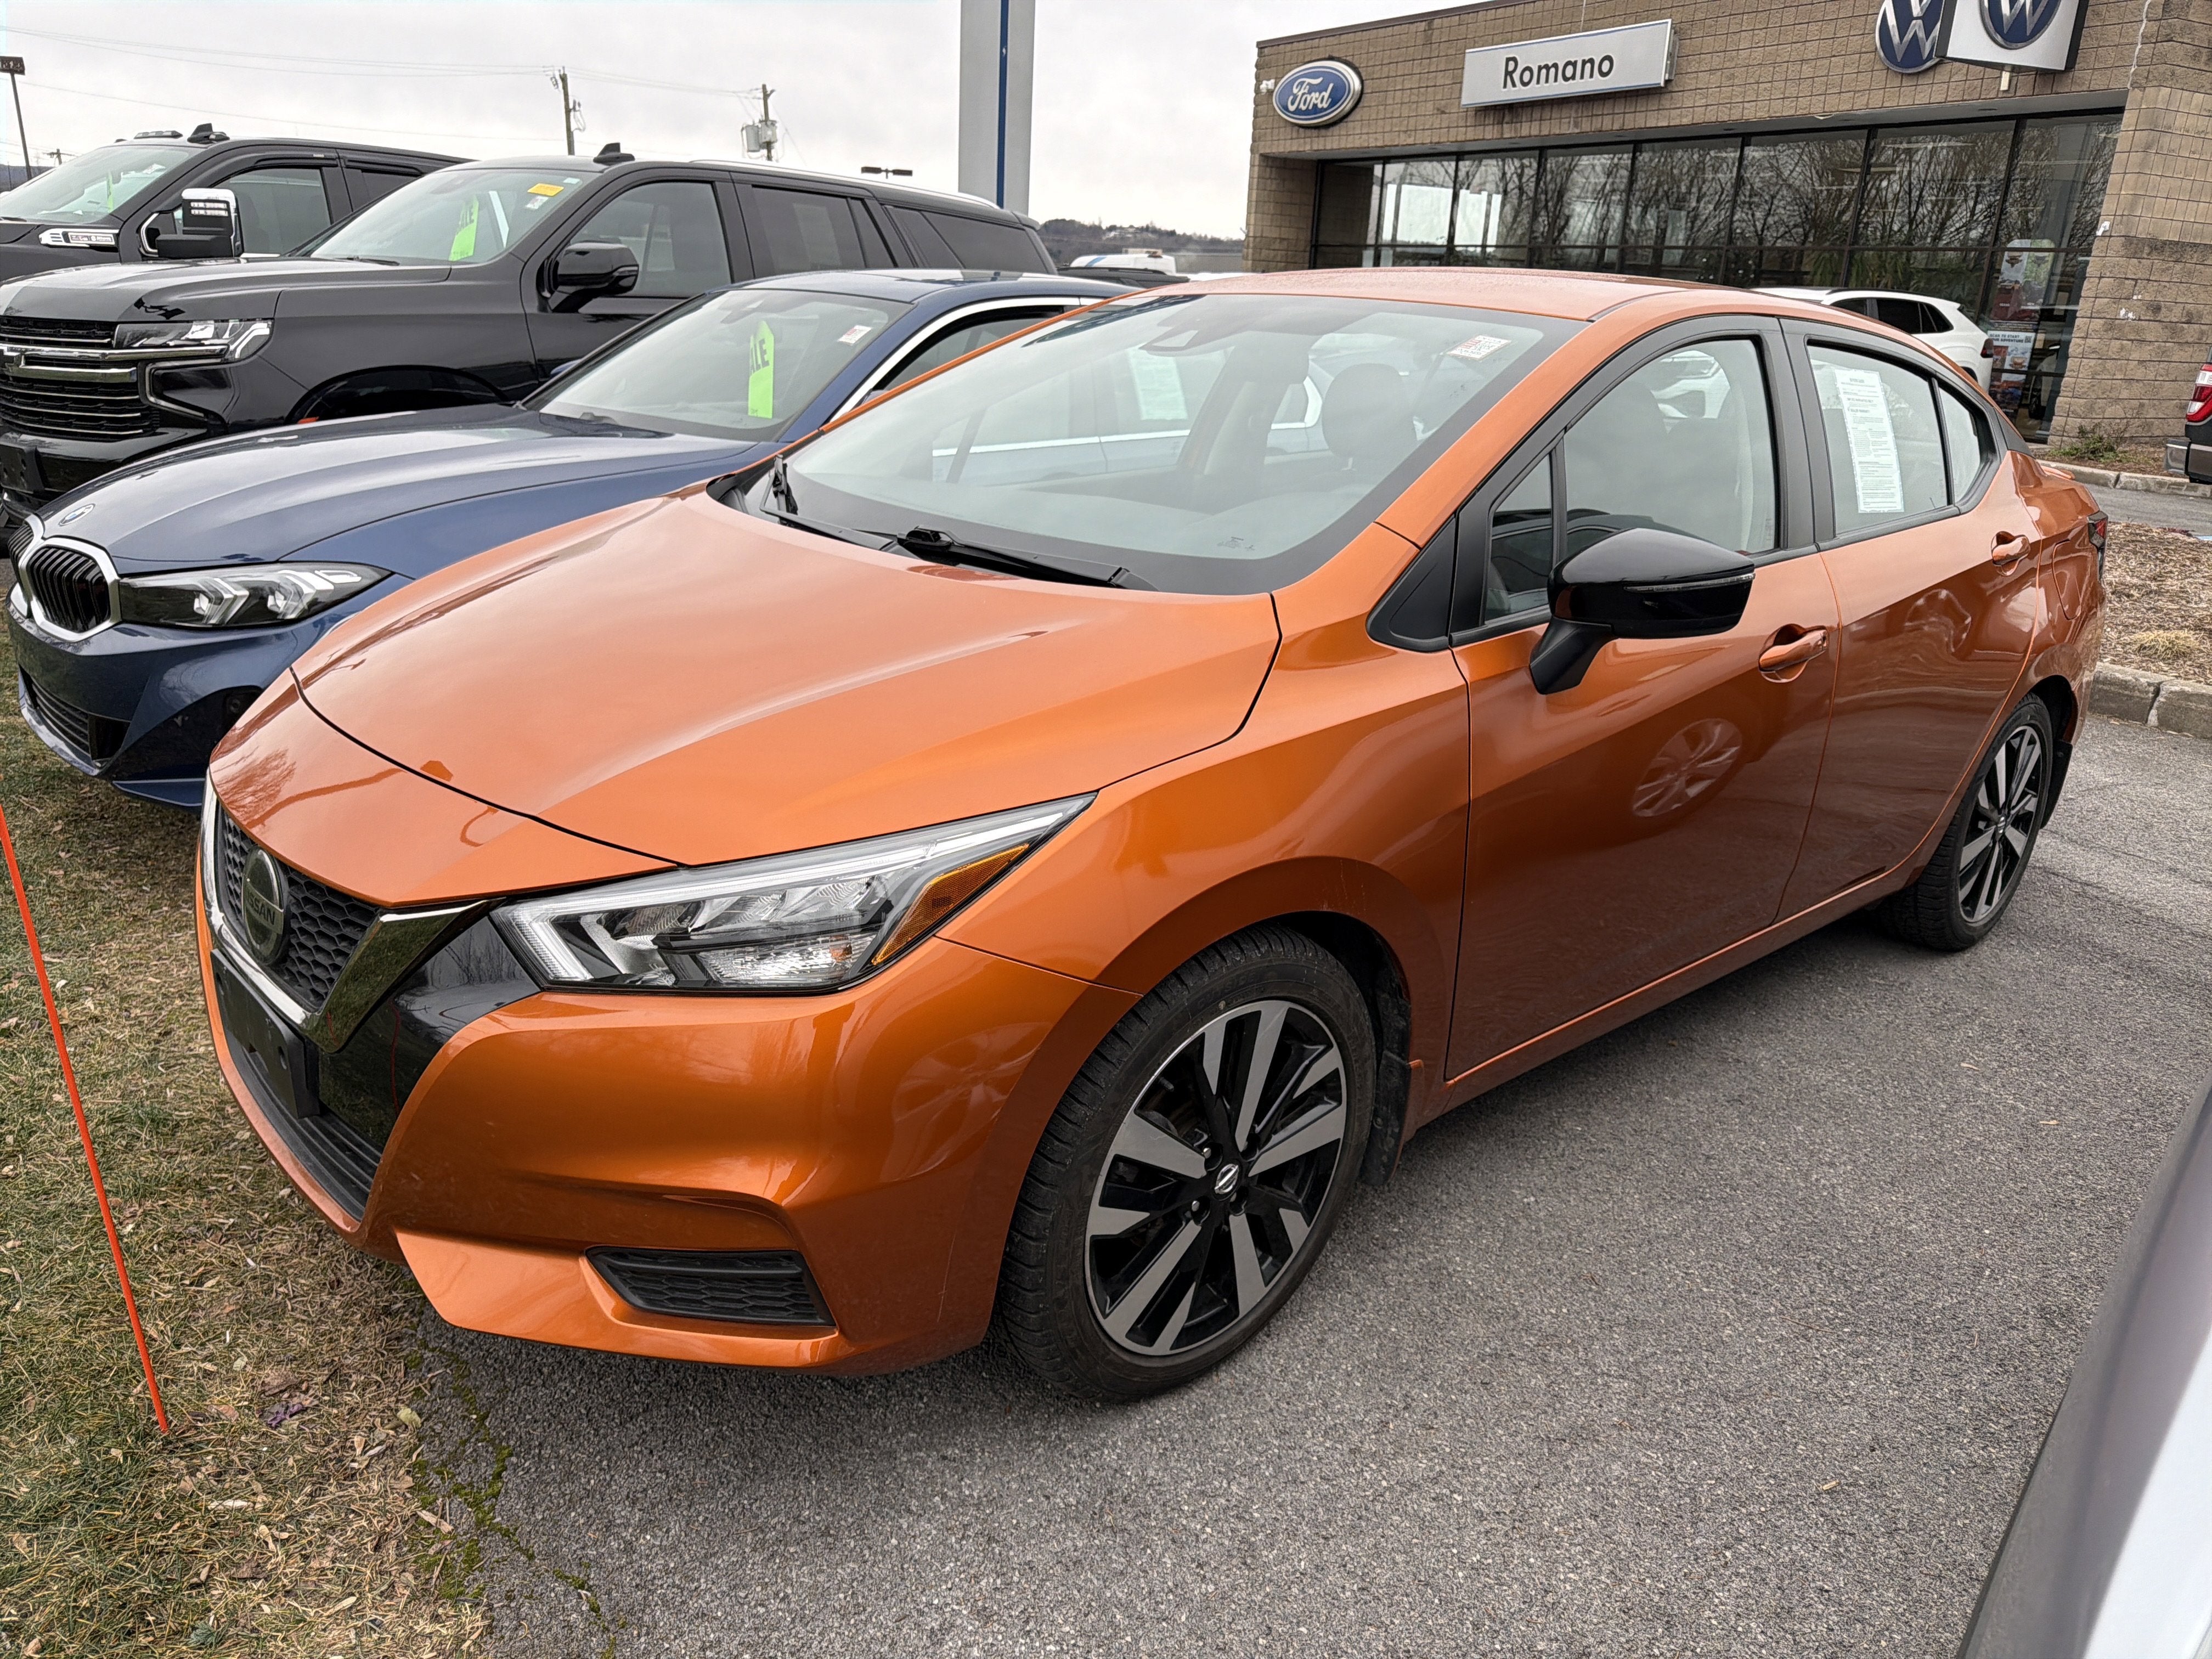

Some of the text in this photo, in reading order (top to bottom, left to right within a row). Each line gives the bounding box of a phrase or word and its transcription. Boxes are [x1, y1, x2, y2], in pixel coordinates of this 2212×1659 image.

[1502, 54, 1614, 89] Romano
[1287, 76, 1335, 112] Ford
[750, 338, 770, 373] ALE
